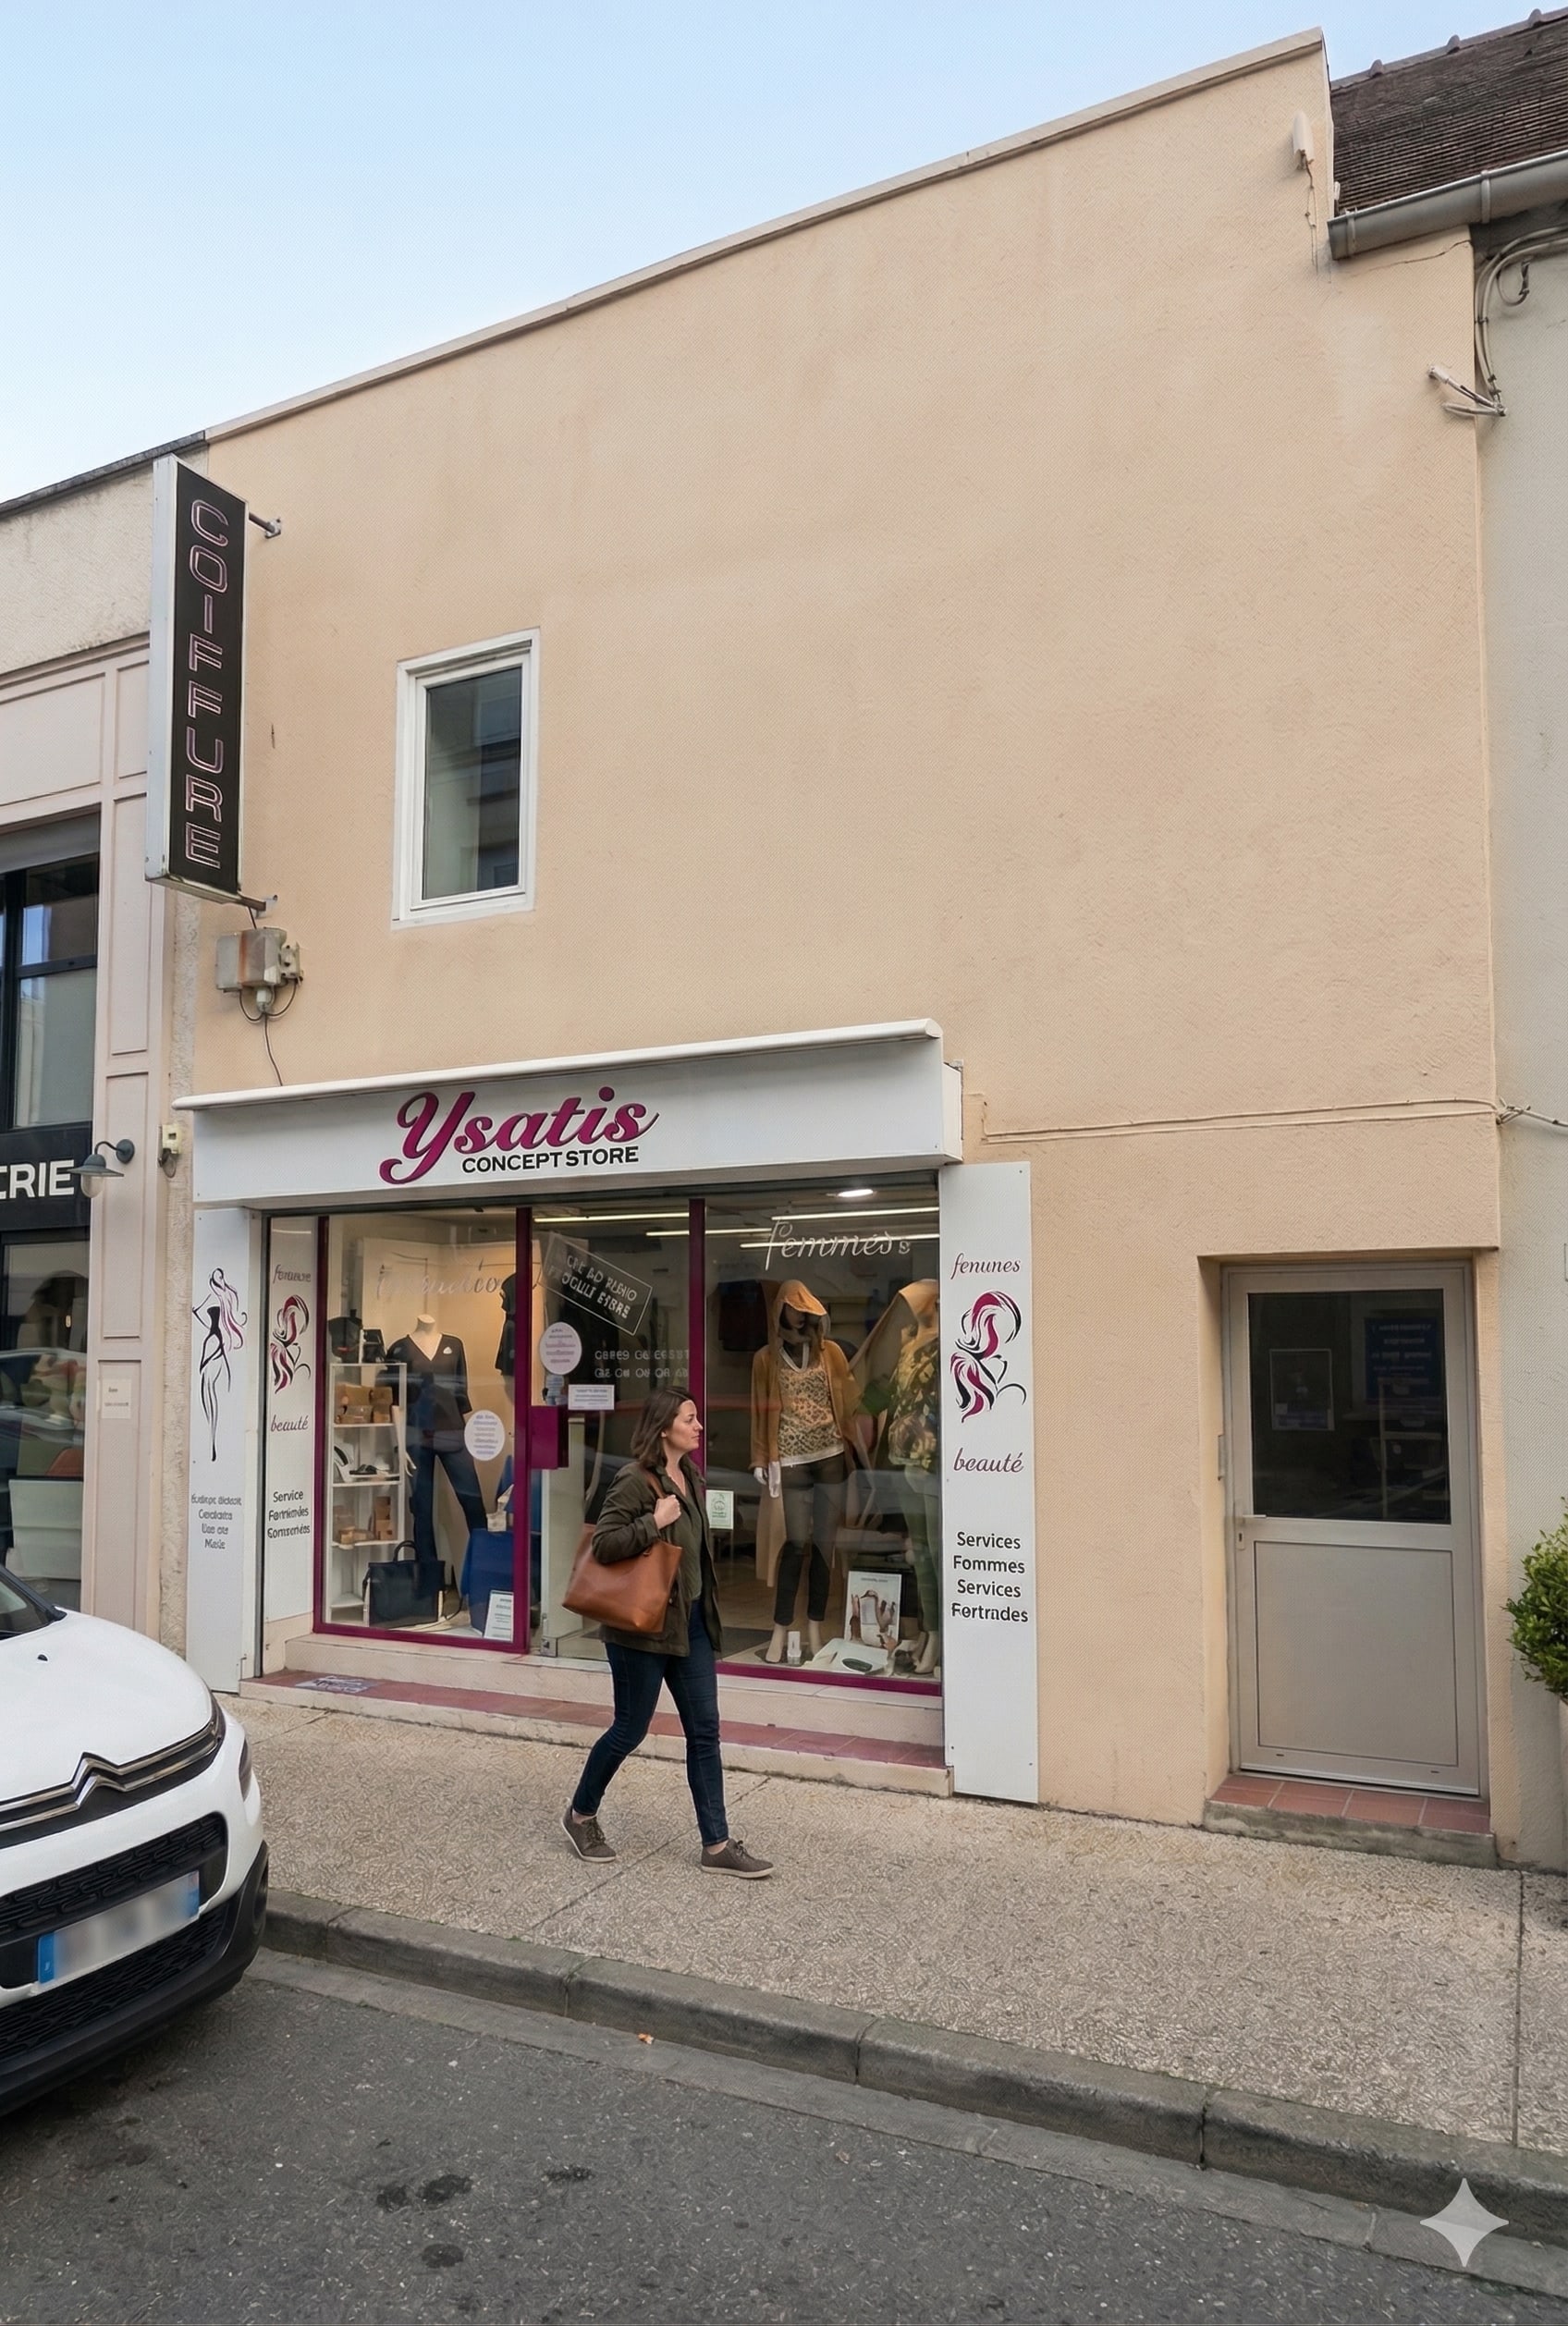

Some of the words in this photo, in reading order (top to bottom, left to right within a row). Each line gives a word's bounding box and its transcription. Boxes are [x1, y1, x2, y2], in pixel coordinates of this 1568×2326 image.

[184, 499, 228, 869] COIFFURE
[379, 1086, 660, 1184] Ysatis
[462, 1151, 562, 1173] CONCEPT
[566, 1146, 639, 1167] STORE
[0, 1159, 75, 1200] RIE
[953, 1447, 1024, 1473] beauté
[273, 1489, 304, 1503] Service
[957, 1531, 1022, 1550] Services
[957, 1579, 1022, 1598] Services
